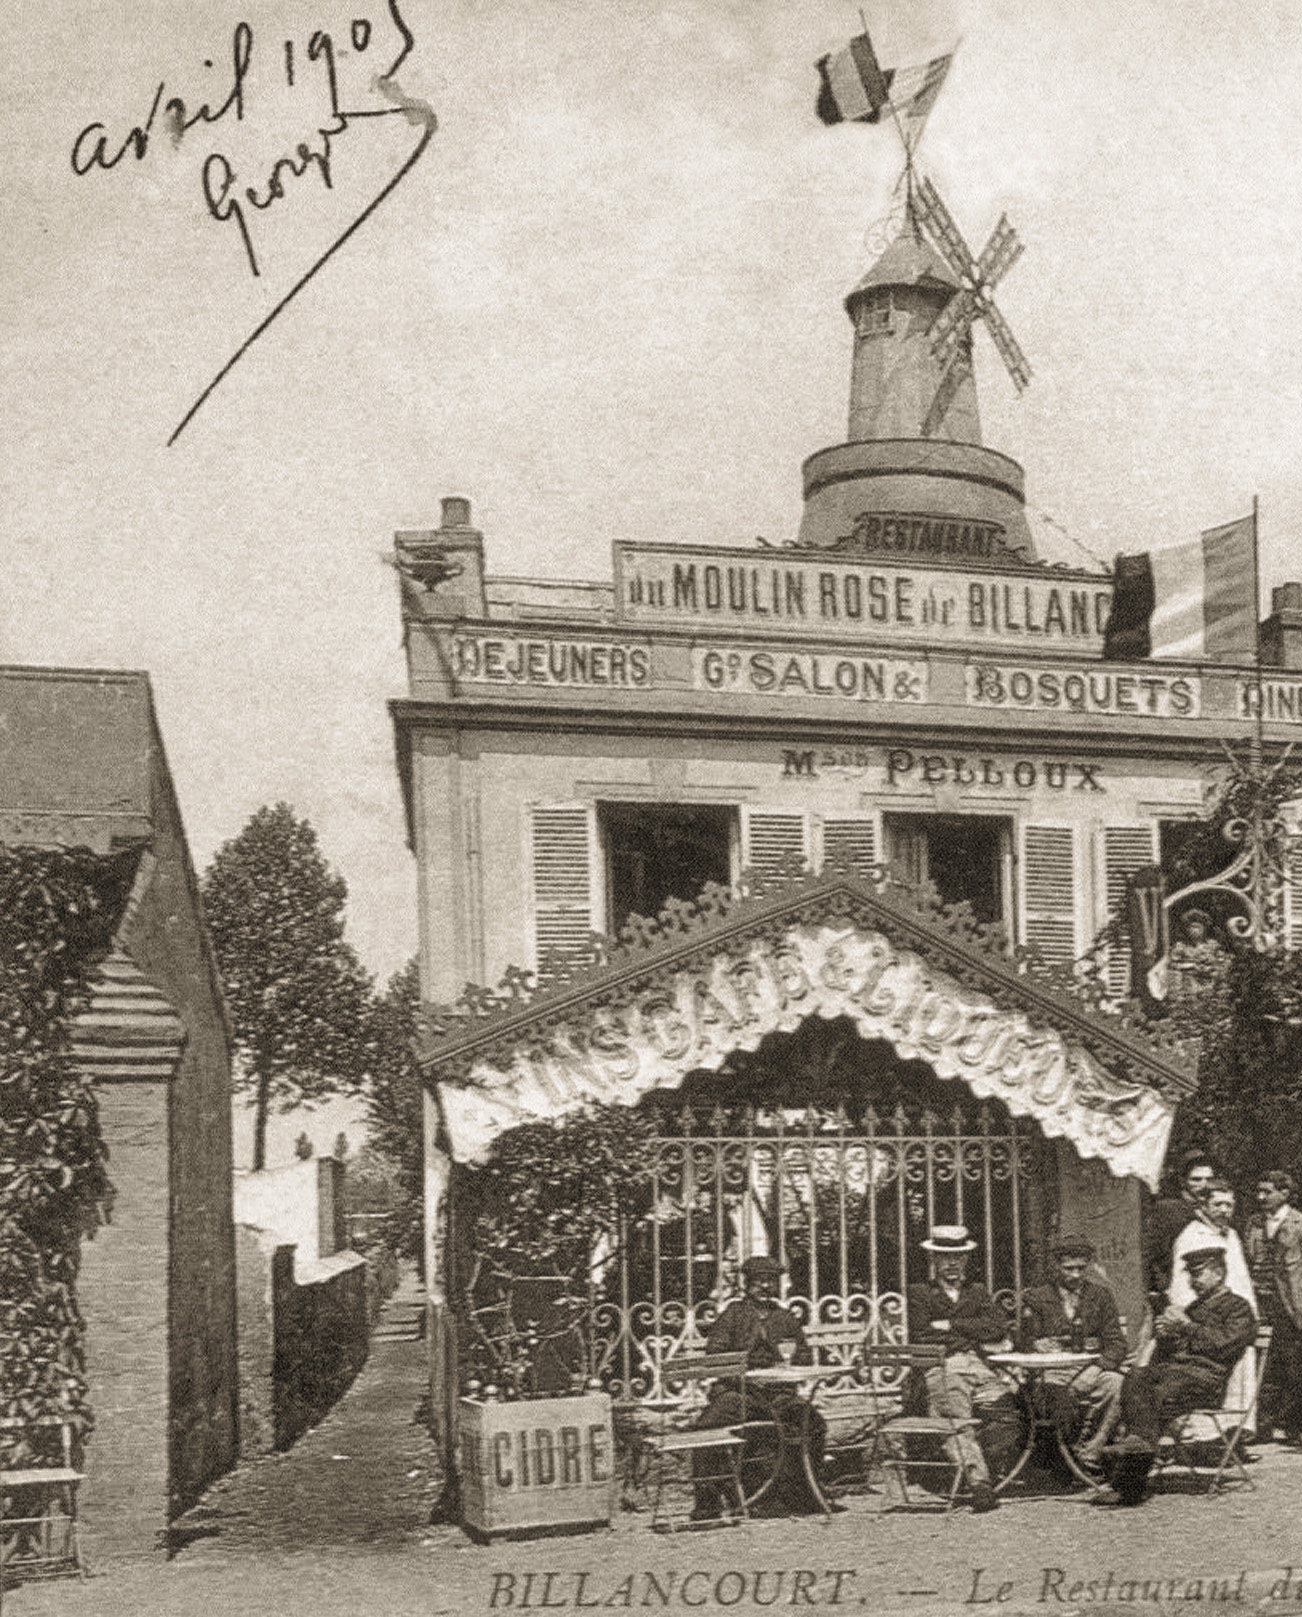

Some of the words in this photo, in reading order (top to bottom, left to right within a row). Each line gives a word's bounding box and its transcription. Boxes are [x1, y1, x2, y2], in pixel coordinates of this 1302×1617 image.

[865, 515, 999, 557] RESTAURANT
[673, 562, 807, 617] MOULIN
[819, 571, 914, 626] ROSE
[749, 652, 886, 699] SALON
[894, 670, 923, 701] &
[973, 666, 1195, 715] BOSQUETS
[494, 1423, 613, 1488] CIDRE
